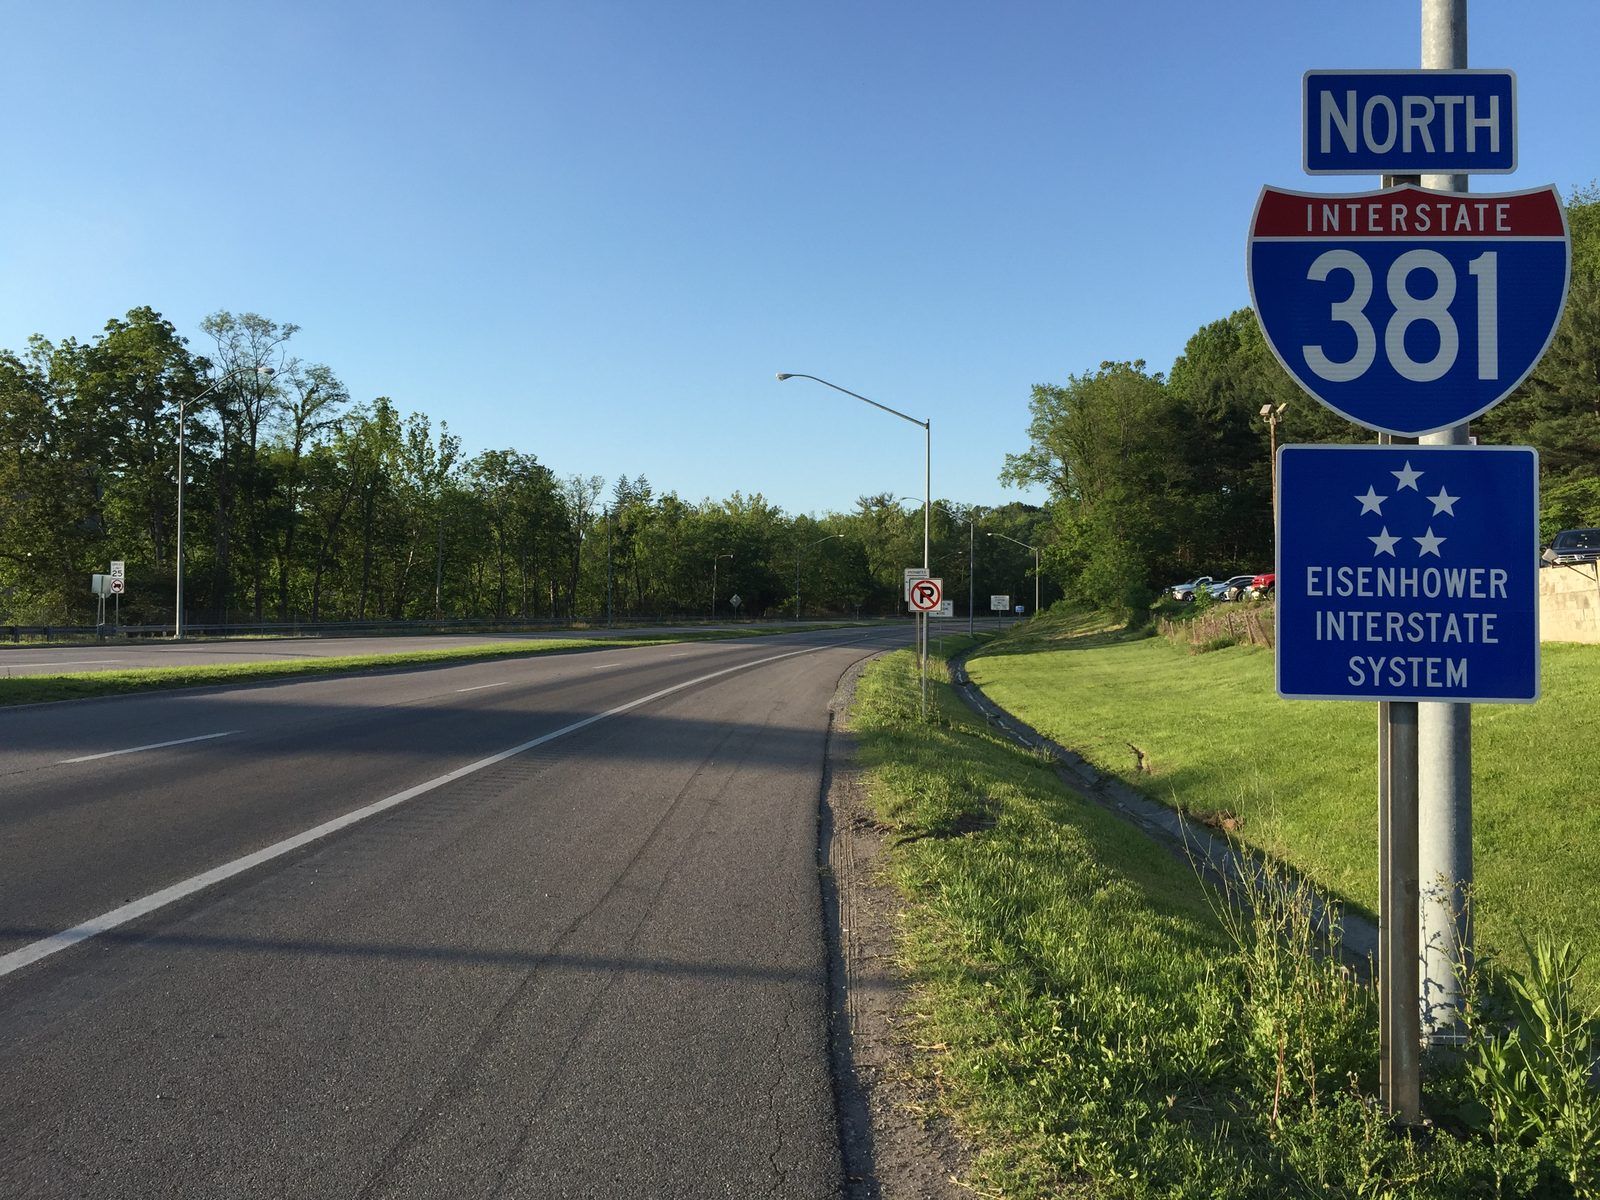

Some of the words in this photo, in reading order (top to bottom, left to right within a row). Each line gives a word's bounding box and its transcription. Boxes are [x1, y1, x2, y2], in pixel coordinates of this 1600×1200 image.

[1320, 90, 1500, 154] NORTH
[1307, 203, 1511, 232] INTERSTATE
[1302, 249, 1499, 382] 381
[919, 587, 934, 603] P
[1306, 566, 1508, 599] EISENHOWER
[1316, 611, 1499, 644] INTERSTATE
[1348, 656, 1468, 688] SYSTEM
